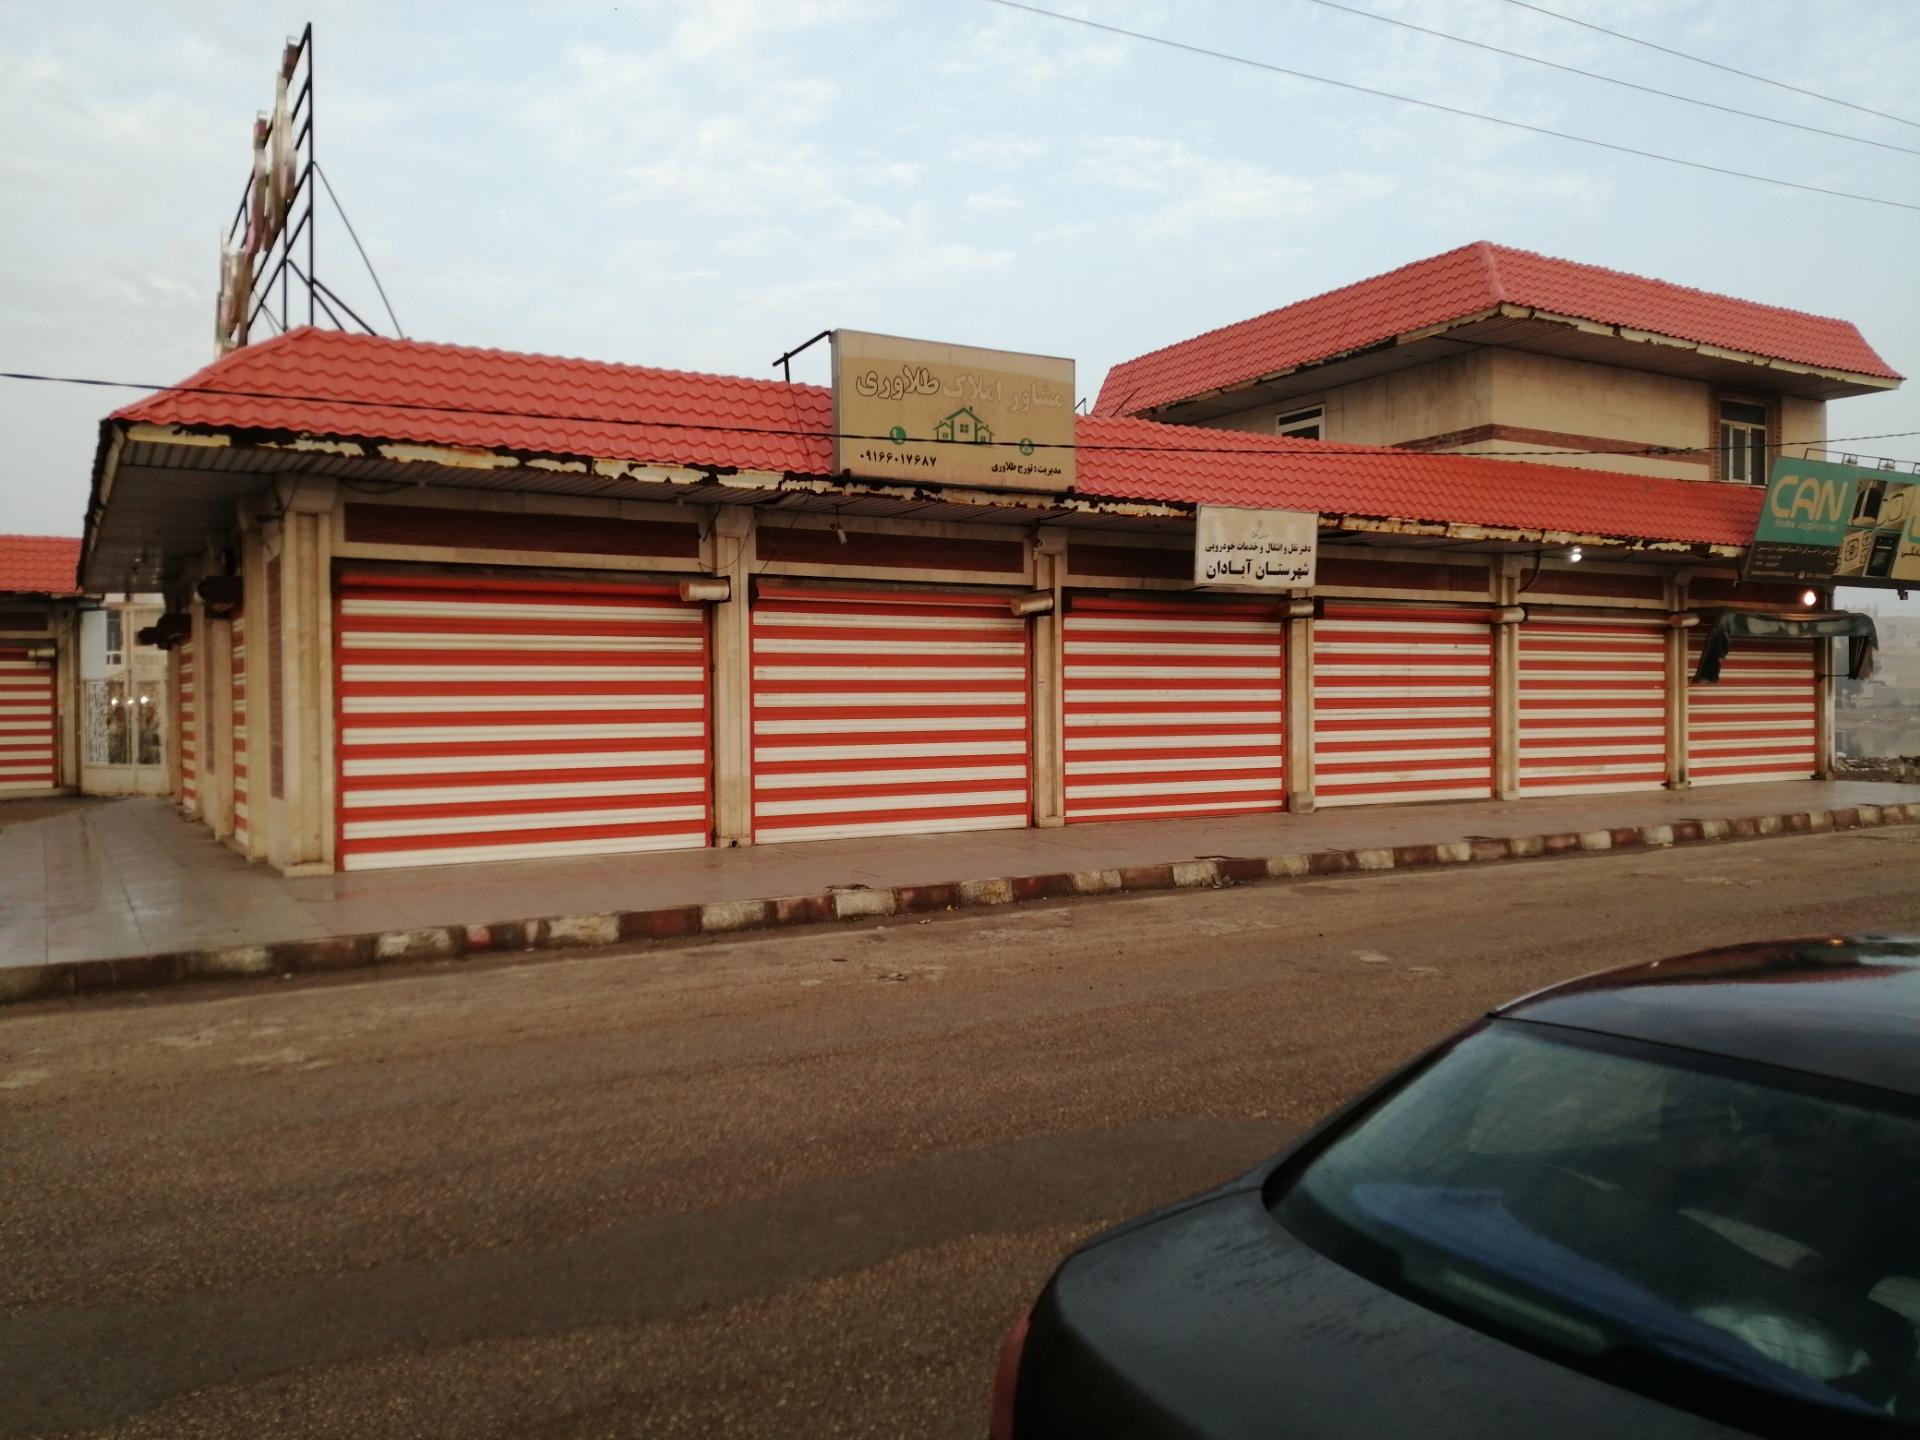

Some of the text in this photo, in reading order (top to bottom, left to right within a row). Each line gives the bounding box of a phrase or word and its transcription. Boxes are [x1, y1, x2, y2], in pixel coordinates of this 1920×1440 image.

[856, 364, 1065, 412] مشاور املاک طلاوری
[860, 450, 937, 467] ۰۹۱۶۶۰۱۷۶۸۷
[1770, 474, 1849, 522] CAN
[1237, 542, 1258, 551] خدمات
[1299, 544, 1311, 555] دفتر
[1206, 559, 1309, 580] شهرستان آبادان
